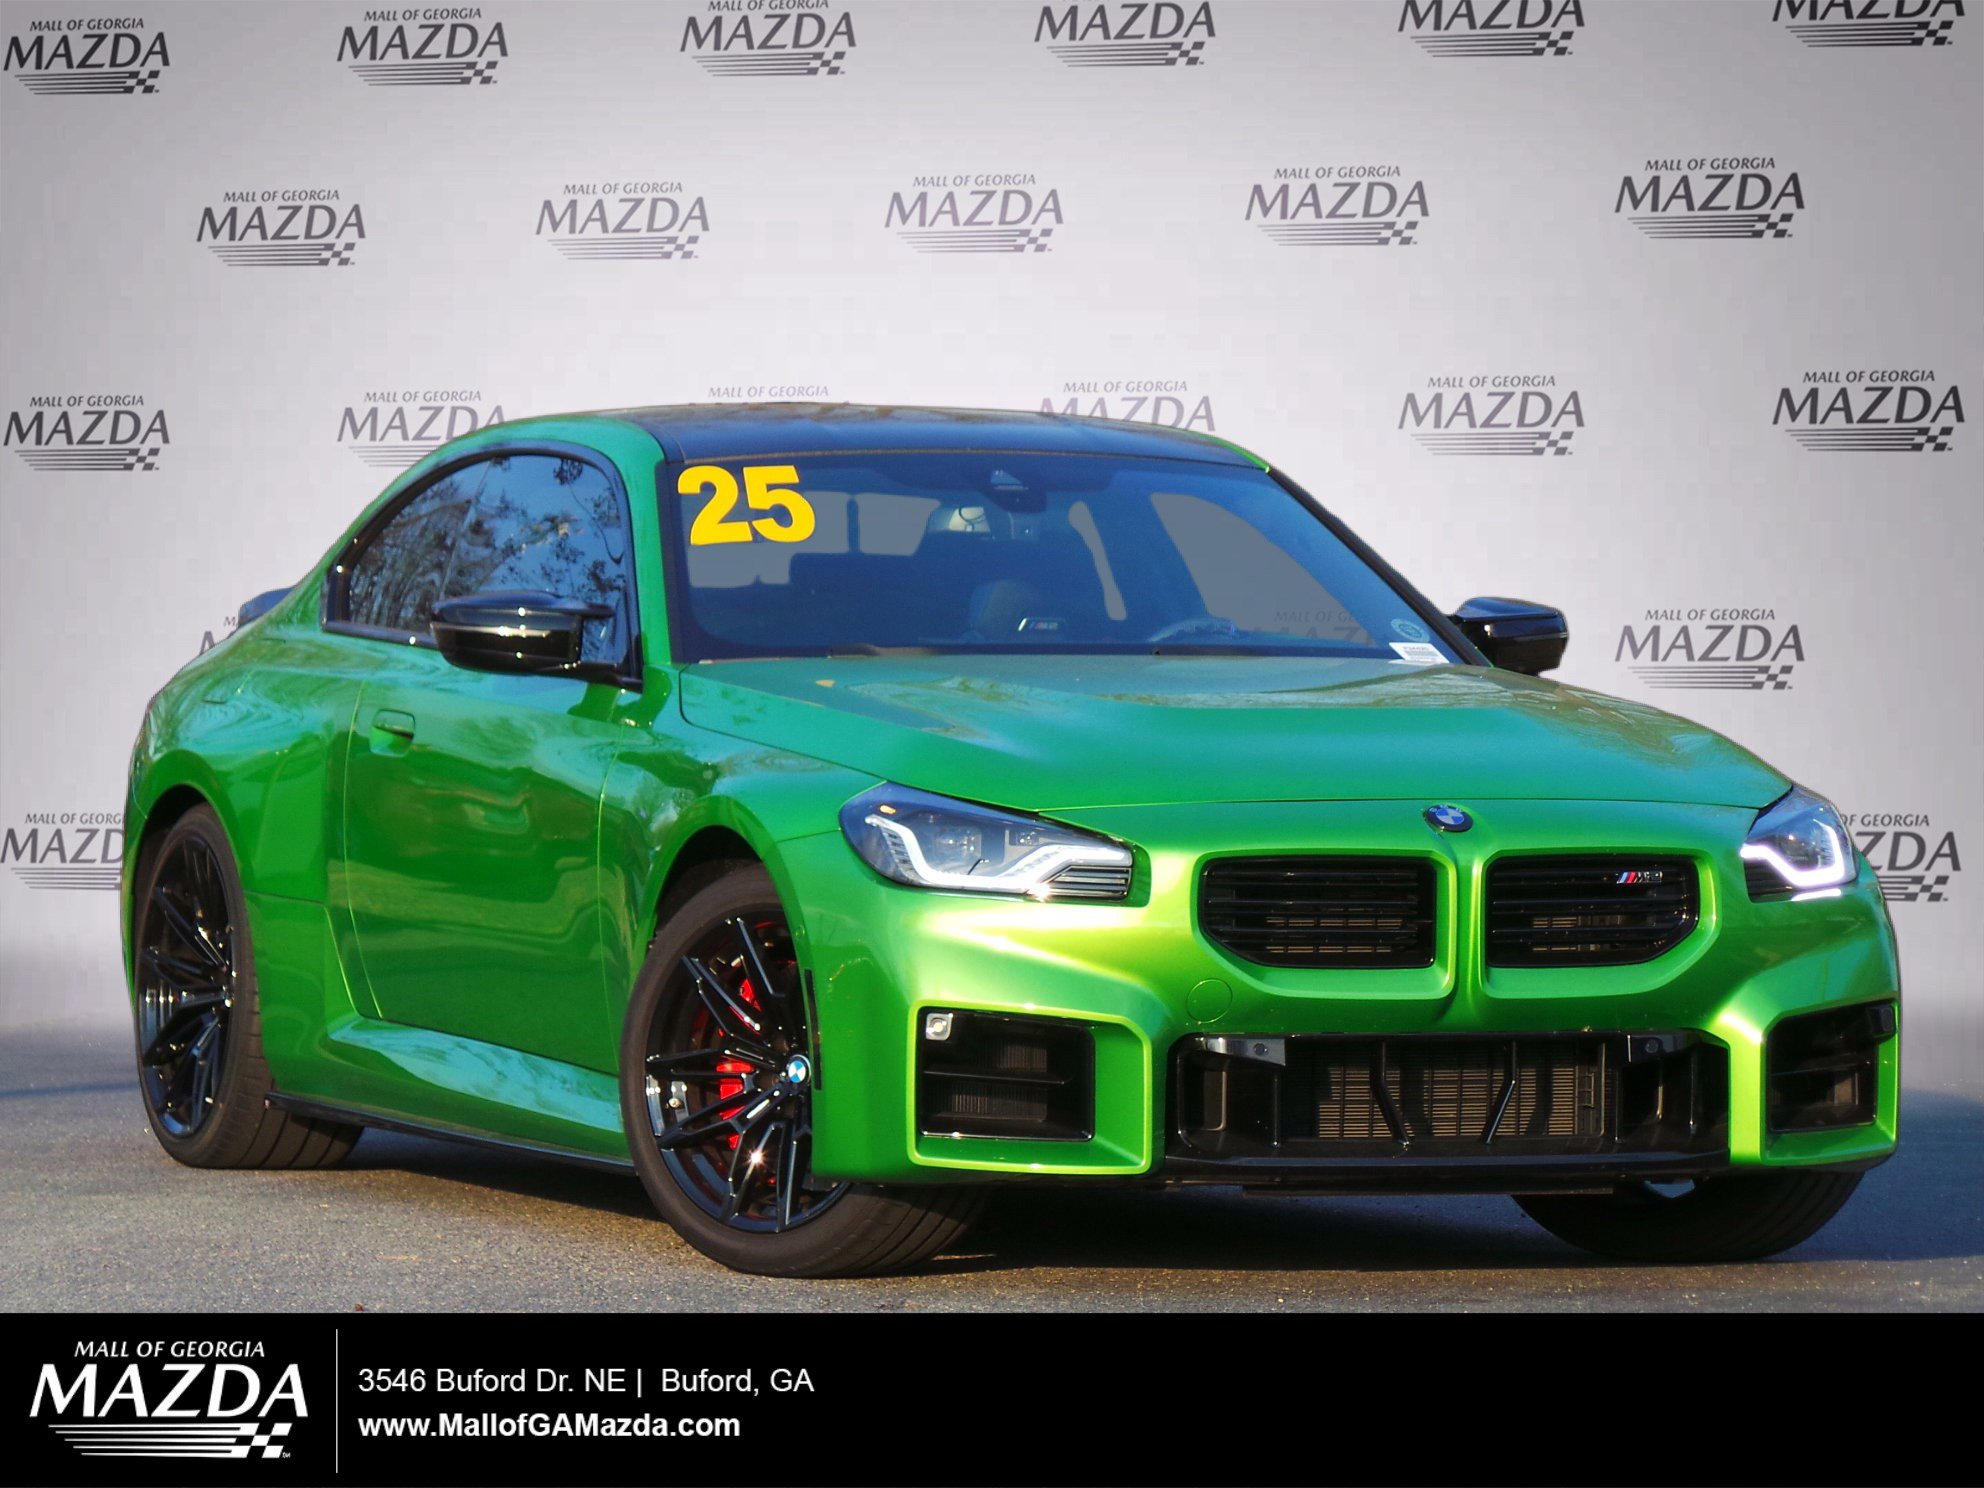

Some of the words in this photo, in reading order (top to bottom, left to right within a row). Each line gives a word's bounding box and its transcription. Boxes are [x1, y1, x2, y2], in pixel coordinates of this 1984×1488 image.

[363, 10, 398, 22] MALL
[401, 9, 420, 22] OF
[423, 8, 482, 20] GEORGIA
[707, 1, 743, 12] MALL
[746, 0, 765, 11] OF
[768, 0, 829, 10] GEORGIA
[1398, 0, 1585, 32] MAZDA
[29, 20, 63, 32] MALL
[66, 19, 85, 32] OF
[87, 18, 144, 31] GEORGIA
[680, 12, 856, 53] MAZDA
[1035, 2, 1215, 42] MAZDA
[3, 32, 170, 71] MAZDA
[337, 22, 508, 62] MAZDA
[1274, 168, 1310, 180] MALL
[1314, 167, 1334, 180] OF
[1338, 165, 1401, 179] GEORGIA
[1644, 160, 1682, 172] MALL
[1686, 159, 1707, 171] OF
[1710, 157, 1776, 171] GEORGIA
[563, 184, 598, 196] MALL
[601, 183, 620, 195] OF
[623, 182, 683, 195] GEORGIA
[913, 176, 948, 188] MALL
[953, 175, 972, 188] OF
[975, 174, 1036, 187] GEORGIA
[223, 192, 257, 203] MALL
[260, 191, 279, 203] OF
[282, 190, 340, 202] GEORGIA
[1245, 180, 1430, 221] MAZDA
[1615, 173, 1805, 213] MAZDA
[536, 197, 710, 236] MAZDA
[885, 189, 1063, 228] MAZDA
[196, 204, 366, 242] MAZDA
[1064, 382, 1099, 393] MALL
[1103, 381, 1123, 393] OF
[1125, 380, 1188, 393] GEORGIA
[1427, 377, 1464, 389] MALL
[1468, 376, 1489, 389] OF
[1492, 375, 1556, 388] GEORGIA
[1803, 372, 1841, 384] MALL
[1845, 371, 1866, 384] OF
[1869, 370, 1935, 383] GEORGIA
[29, 397, 63, 408] MALL
[66, 396, 85, 408] OF
[87, 395, 144, 408] GEORGIA
[364, 392, 398, 404] MALL
[401, 391, 420, 403] OF
[423, 391, 482, 403] GEORGIA
[708, 387, 743, 398] MALL
[747, 386, 766, 398] OF
[768, 385, 829, 398] GEORGIA
[1398, 391, 1585, 430] MAZDA
[1773, 386, 1965, 425] MAZDA
[3, 410, 170, 446] MAZDA
[677, 465, 816, 546] 25
[1644, 610, 1682, 621] MALL
[1686, 609, 1707, 621] OF
[1710, 608, 1776, 621] GEORGIA
[1615, 624, 1805, 662] MAZDA
[25, 813, 56, 824] MALL
[60, 813, 77, 825] OF
[80, 813, 122, 825] GEORG
[1861, 814, 1930, 827] GEORGIA
[0, 828, 124, 864] MAZD
[1855, 831, 1961, 872] ZDA
